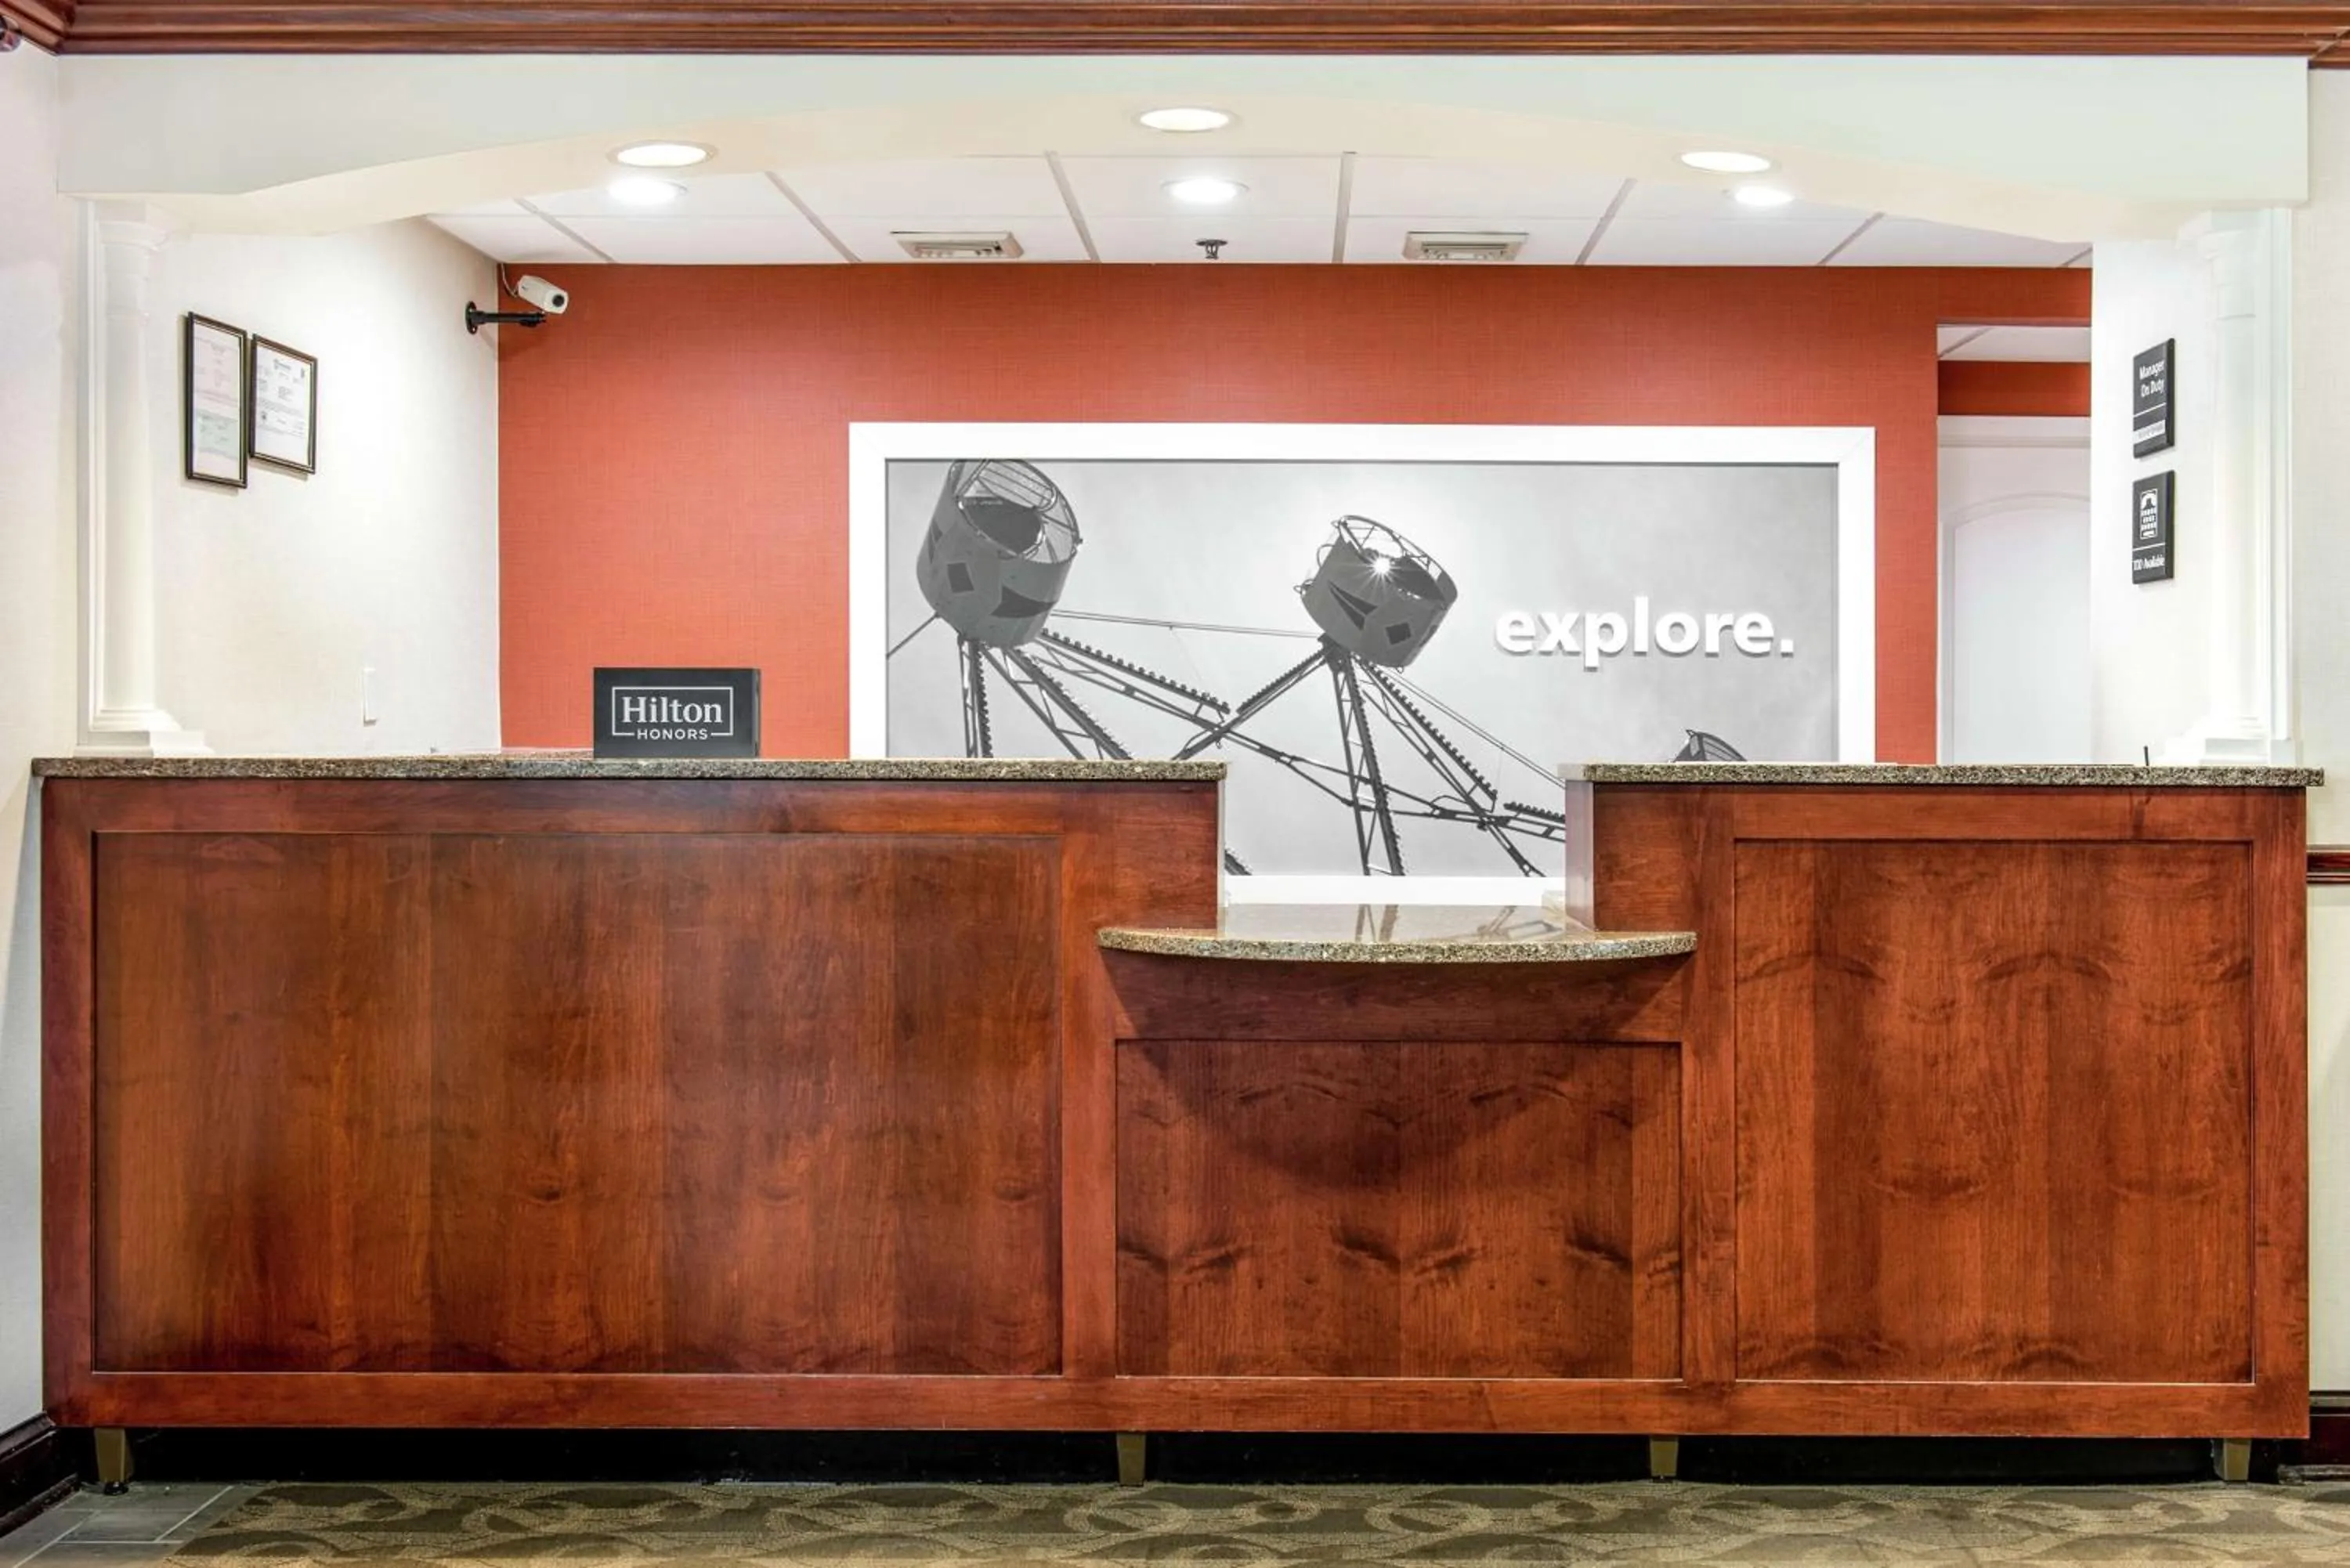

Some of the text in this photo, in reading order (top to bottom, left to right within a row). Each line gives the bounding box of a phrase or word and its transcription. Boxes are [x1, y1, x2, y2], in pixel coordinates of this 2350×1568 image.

[2139, 359, 2164, 380] Manager
[2141, 379, 2164, 398] On Duty
[1495, 596, 1794, 670] explore.
[621, 696, 722, 724] Hilton
[637, 728, 708, 740] HONORS
